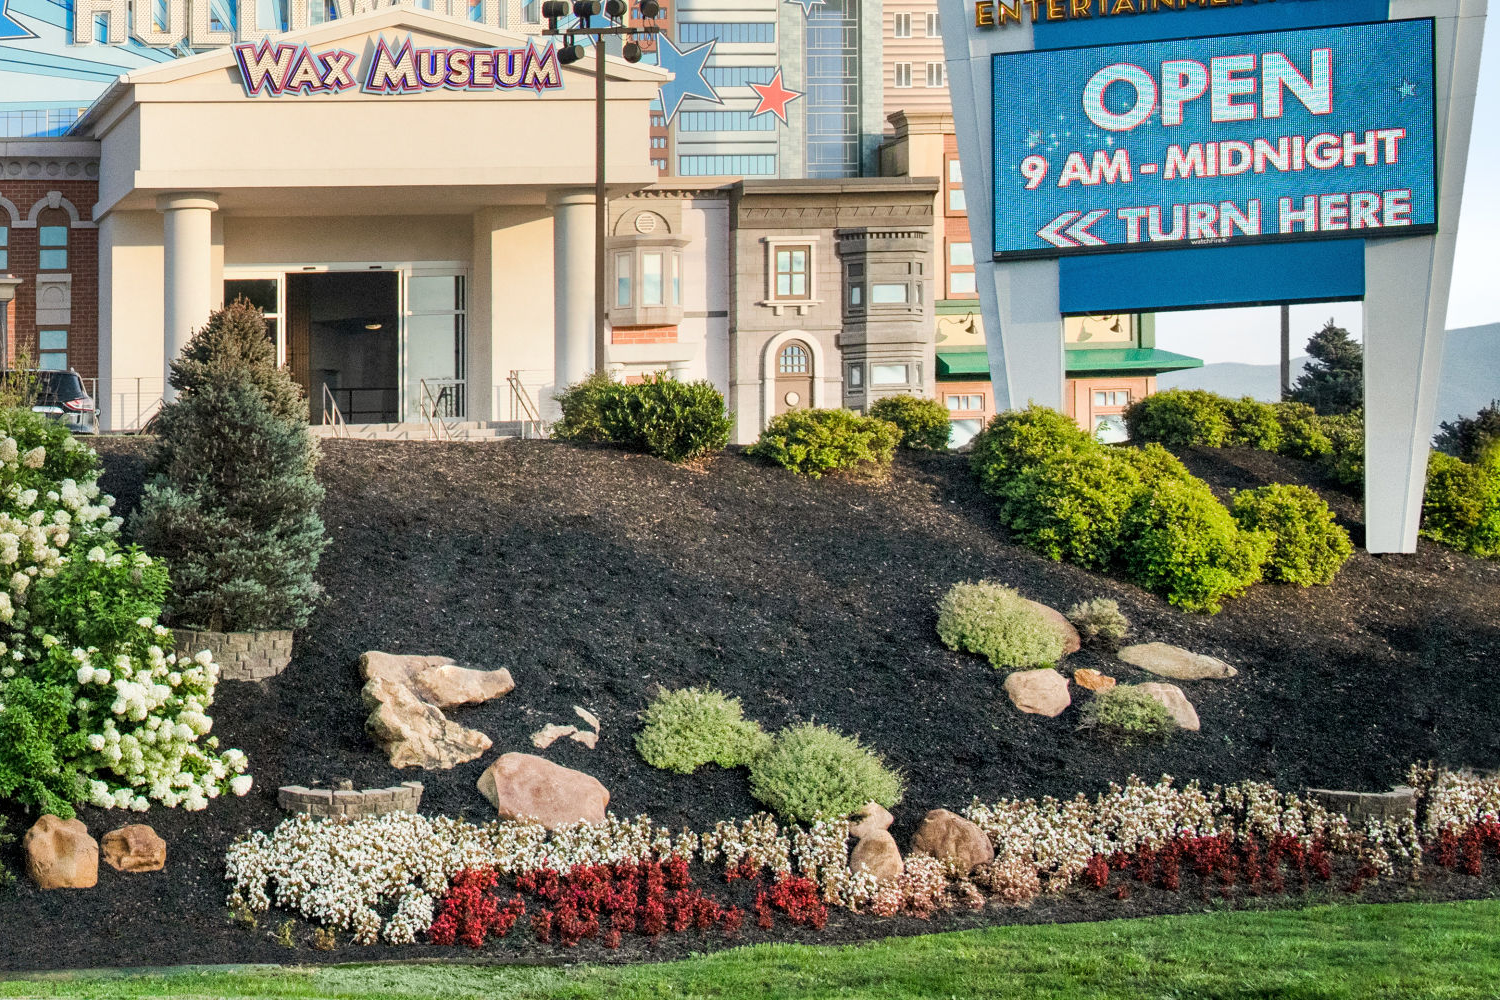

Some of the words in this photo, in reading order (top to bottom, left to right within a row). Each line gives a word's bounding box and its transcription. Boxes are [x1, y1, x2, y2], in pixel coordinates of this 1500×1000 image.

[234, 36, 358, 97] WAX
[364, 32, 564, 96] MUSEUM
[1082, 47, 1332, 131] OPEN
[1020, 155, 1049, 190] 9
[1117, 198, 1261, 243] TURN
[1278, 188, 1412, 233] HERE
